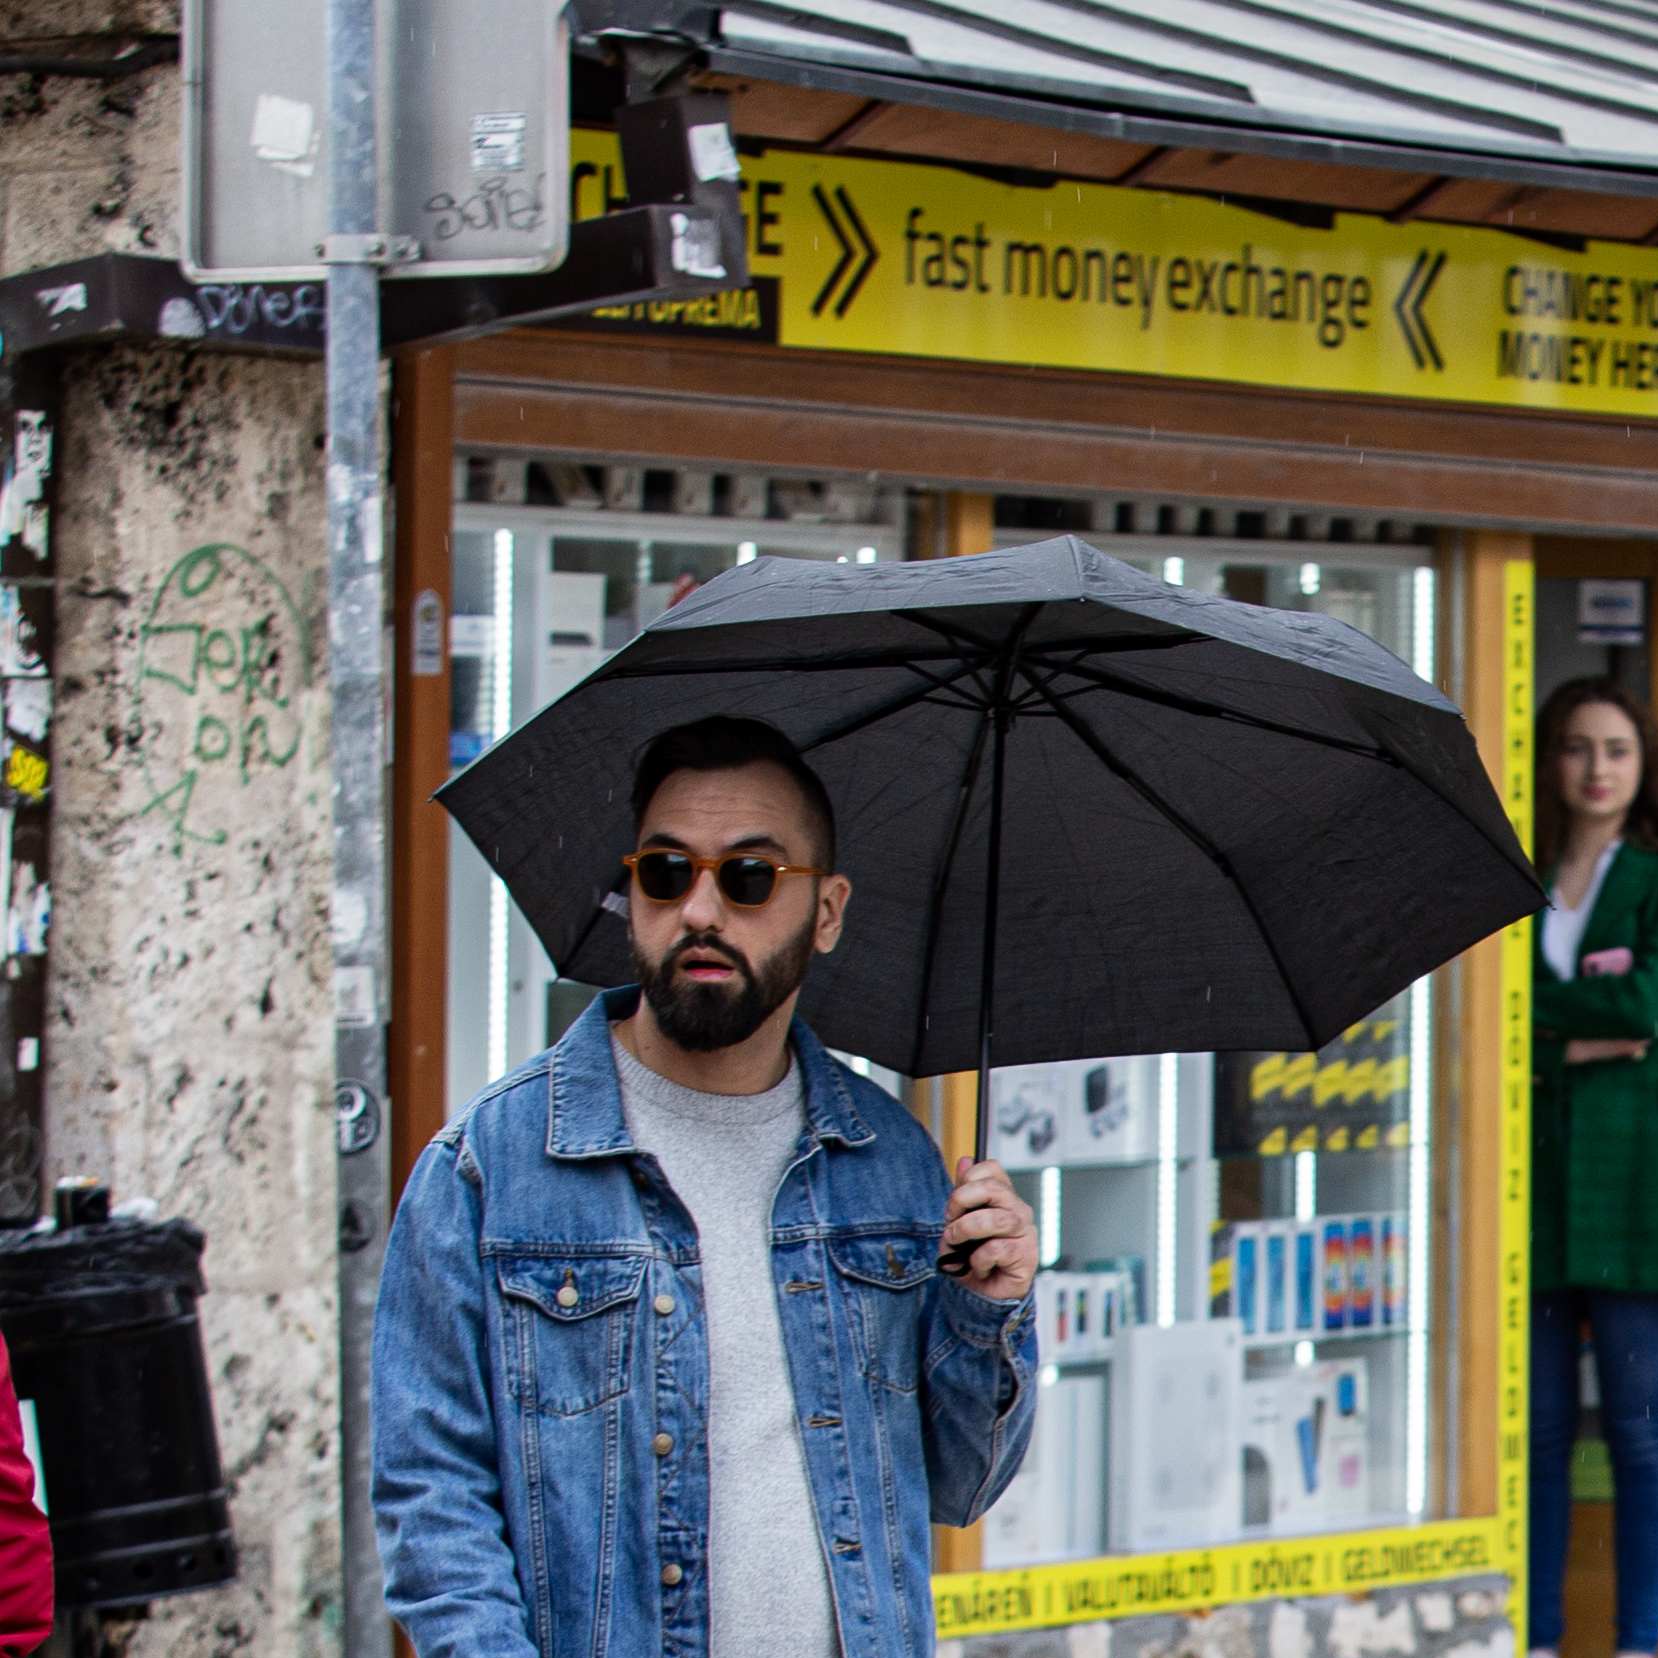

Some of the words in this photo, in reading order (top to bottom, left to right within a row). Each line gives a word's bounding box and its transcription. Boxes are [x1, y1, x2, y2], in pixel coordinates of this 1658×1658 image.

[904, 207, 991, 295] fast
[1004, 240, 1162, 329] money
[1169, 244, 1373, 350] exchange
[1502, 263, 1621, 326] CHANGE
[1496, 332, 1604, 388] MONEY
[1341, 1533, 1491, 1583] GELDWECHSEL
